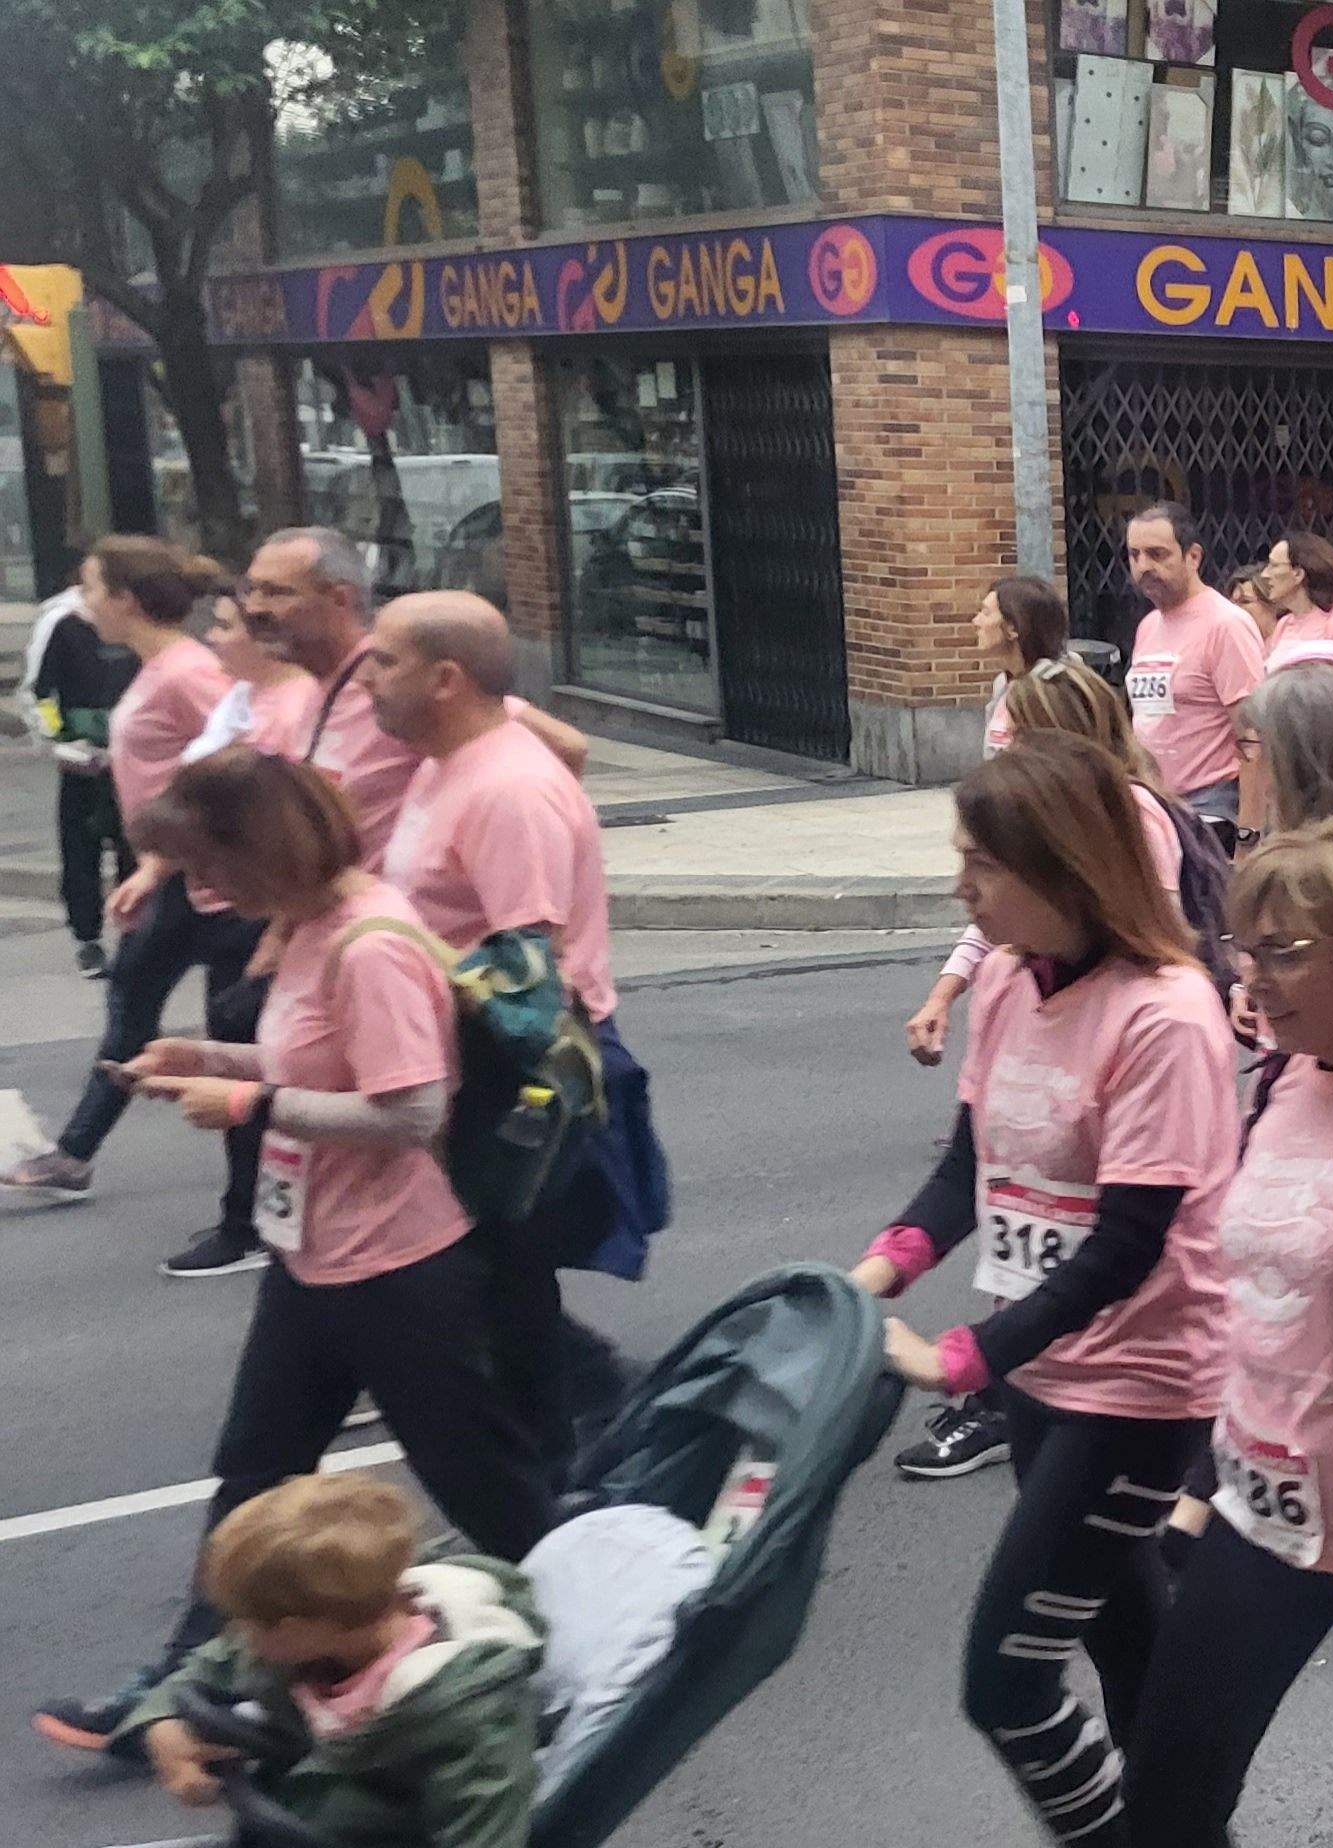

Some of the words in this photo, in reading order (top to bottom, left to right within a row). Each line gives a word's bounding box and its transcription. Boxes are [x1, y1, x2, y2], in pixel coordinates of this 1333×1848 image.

[440, 260, 544, 328] GANGA
[646, 237, 786, 321] GANGA
[990, 1215, 1062, 1270] 318
